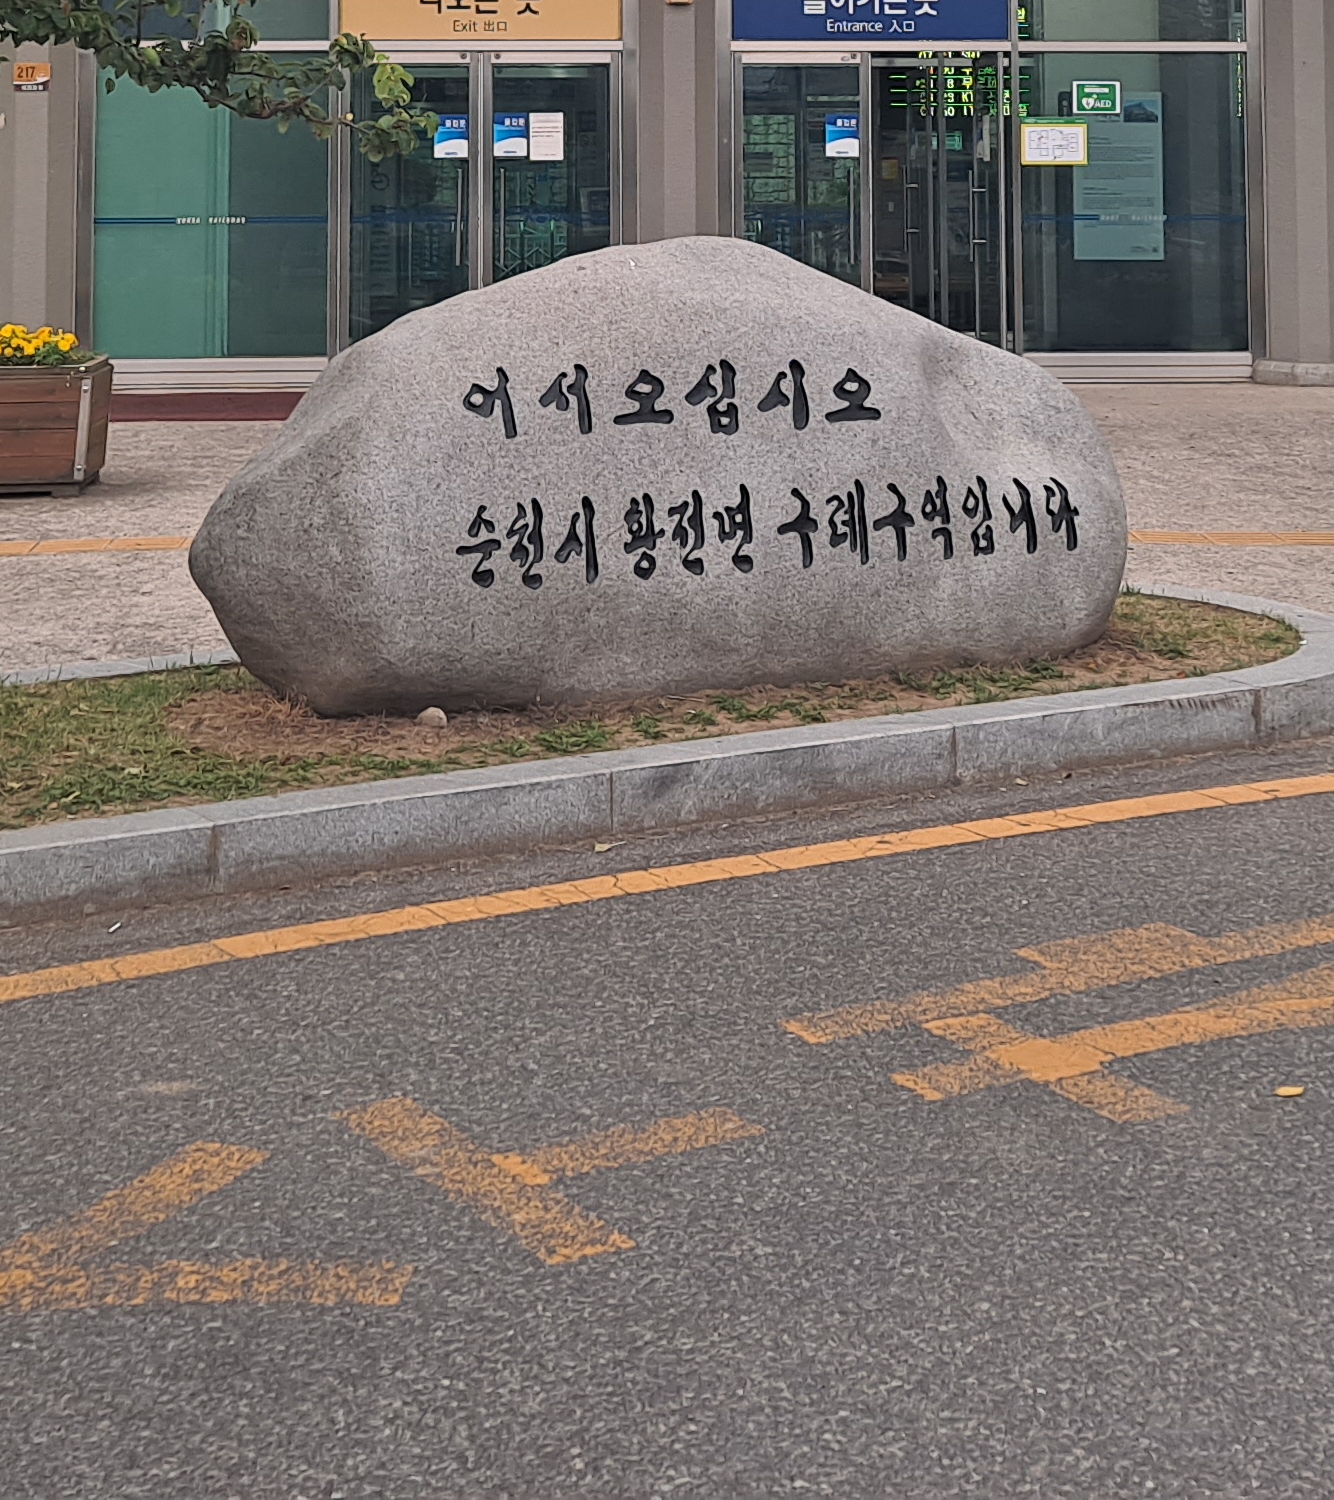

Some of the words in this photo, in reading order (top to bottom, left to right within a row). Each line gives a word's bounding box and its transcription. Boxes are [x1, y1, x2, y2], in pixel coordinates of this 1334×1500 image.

[453, 20, 477, 32] Exit
[483, 20, 508, 32] 出口
[826, 19, 883, 32] Entrance
[888, 19, 915, 33] 入口
[17, 65, 36, 79] 217
[1093, 99, 1112, 108] AED
[462, 358, 882, 439] 어서오십시오
[455, 497, 599, 589] 순천시
[623, 483, 753, 581] 황전면
[776, 474, 1080, 568] 구례구역입니다
